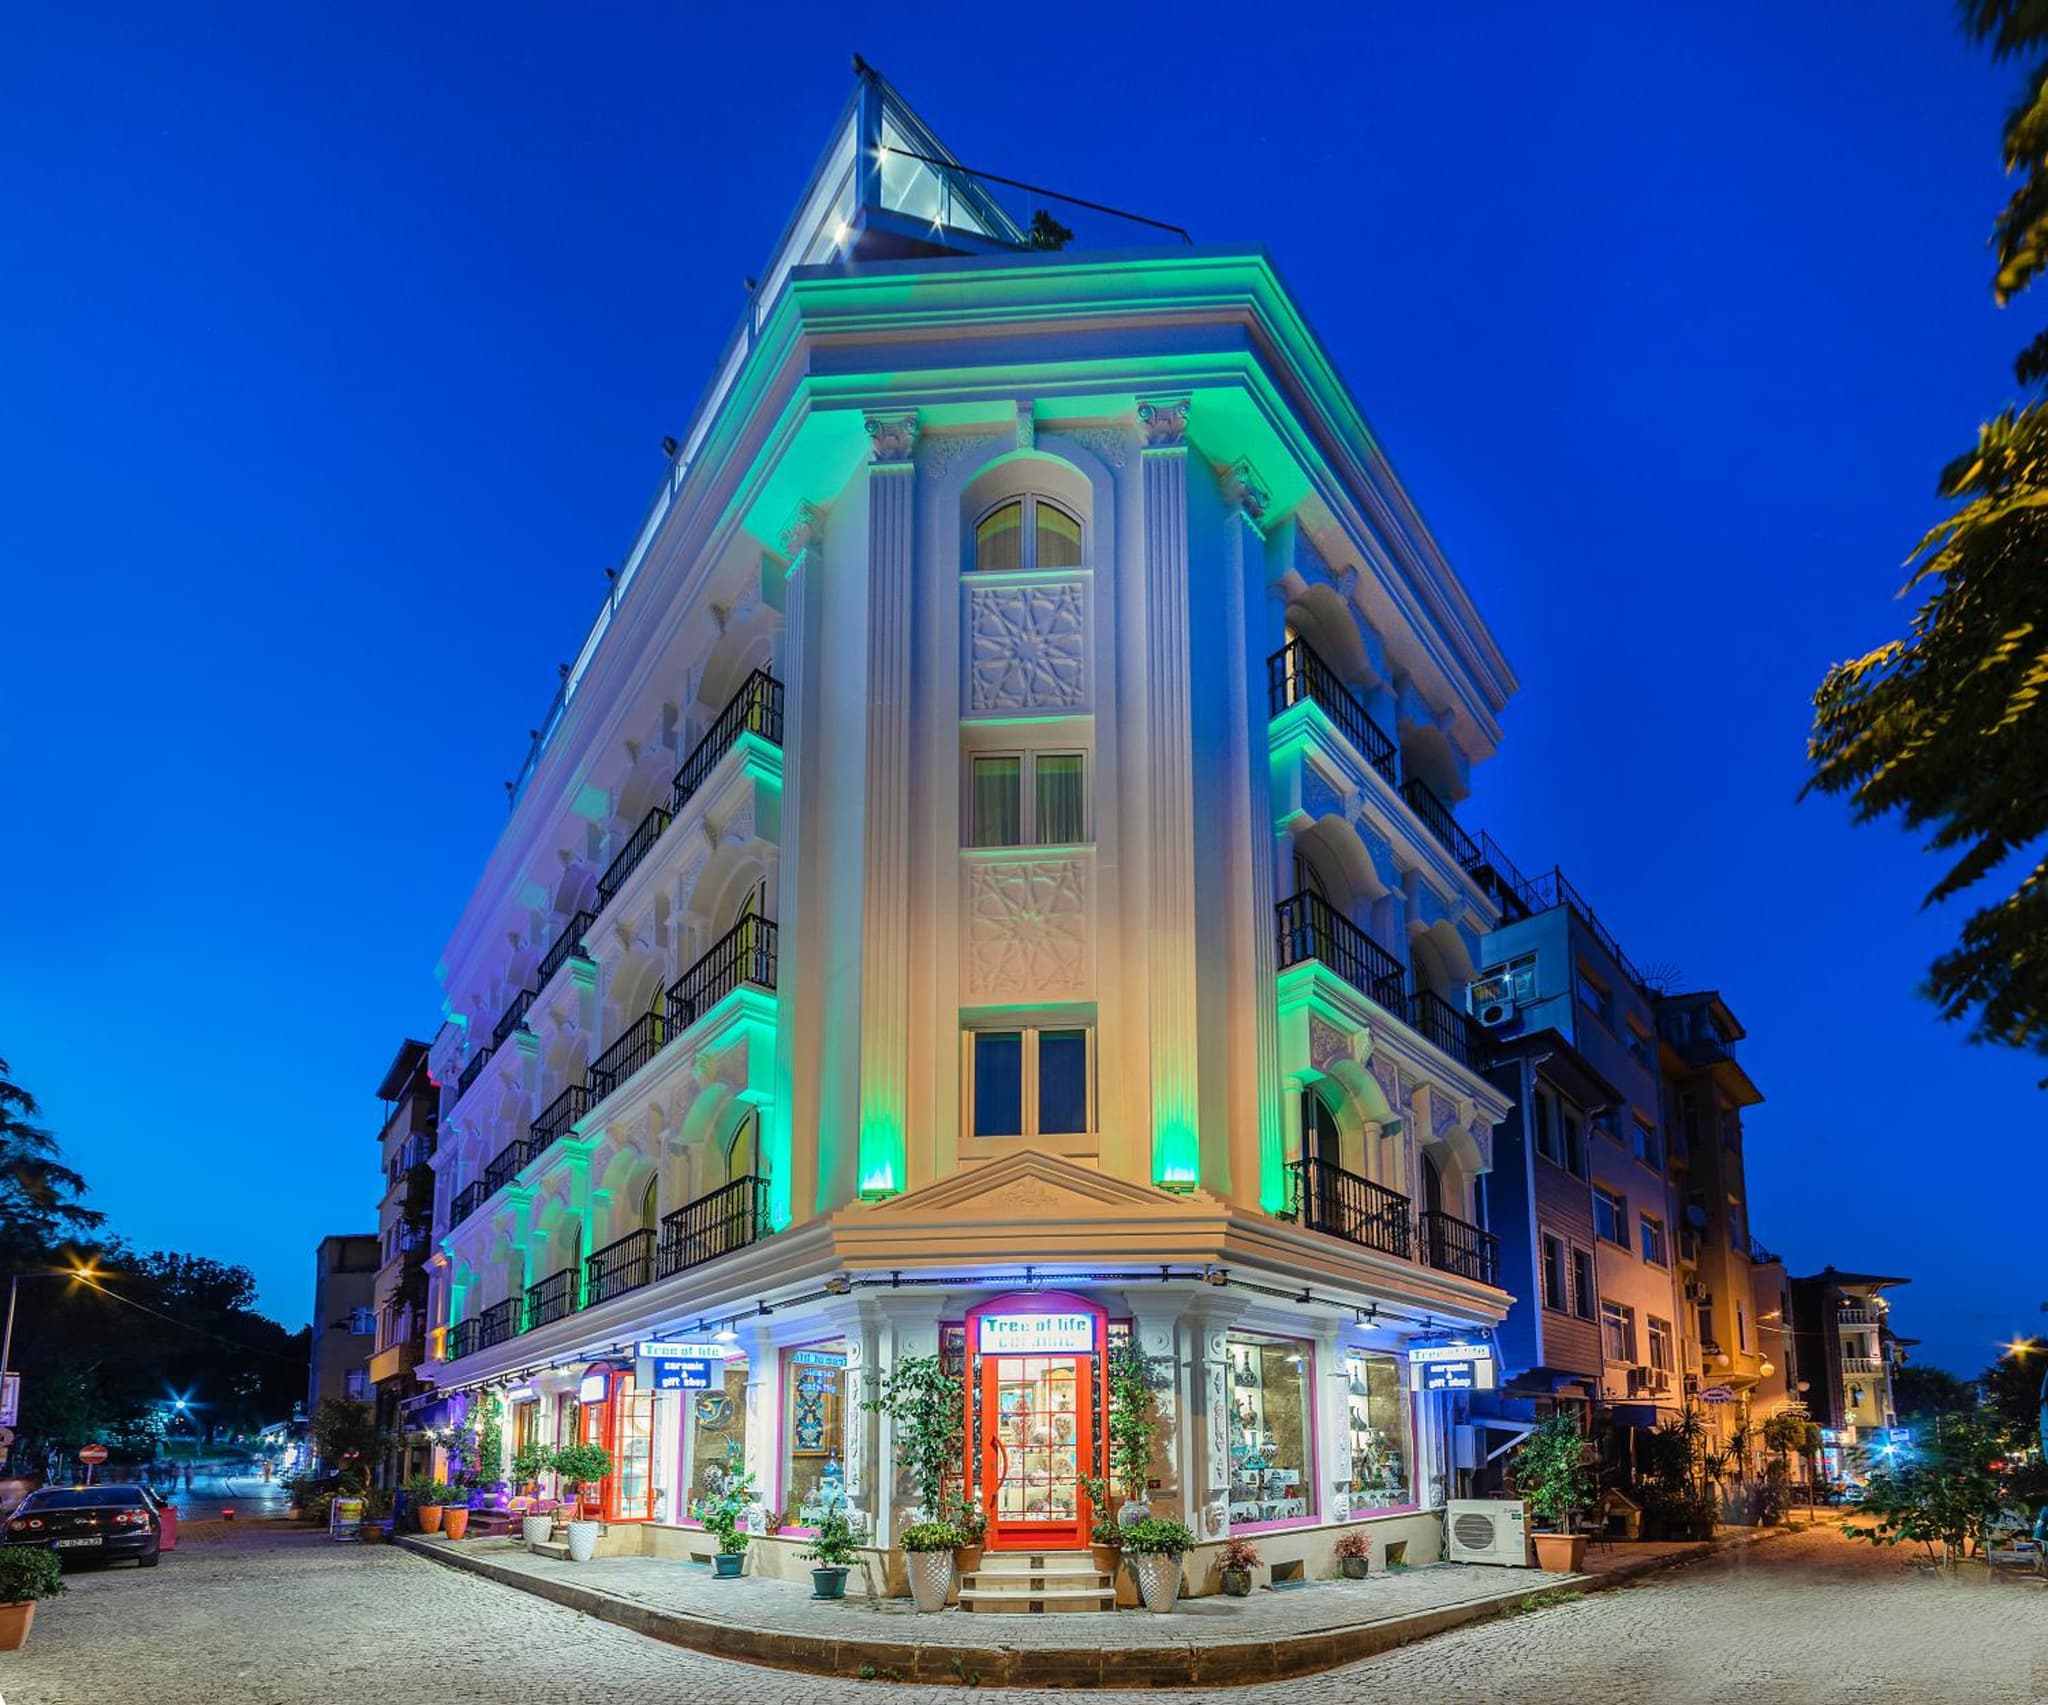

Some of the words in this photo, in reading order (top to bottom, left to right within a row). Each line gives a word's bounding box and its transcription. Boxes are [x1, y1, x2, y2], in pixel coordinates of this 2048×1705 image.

[986, 1319, 1030, 1332] Tree
[1036, 1318, 1052, 1332] of
[1058, 1318, 1087, 1331] life
[645, 1345, 677, 1355] Tree
[681, 1346, 693, 1355] of
[698, 1347, 719, 1356] life
[664, 1361, 705, 1370] ceramic
[662, 1377, 681, 1388] gift
[683, 1378, 707, 1388] shop
